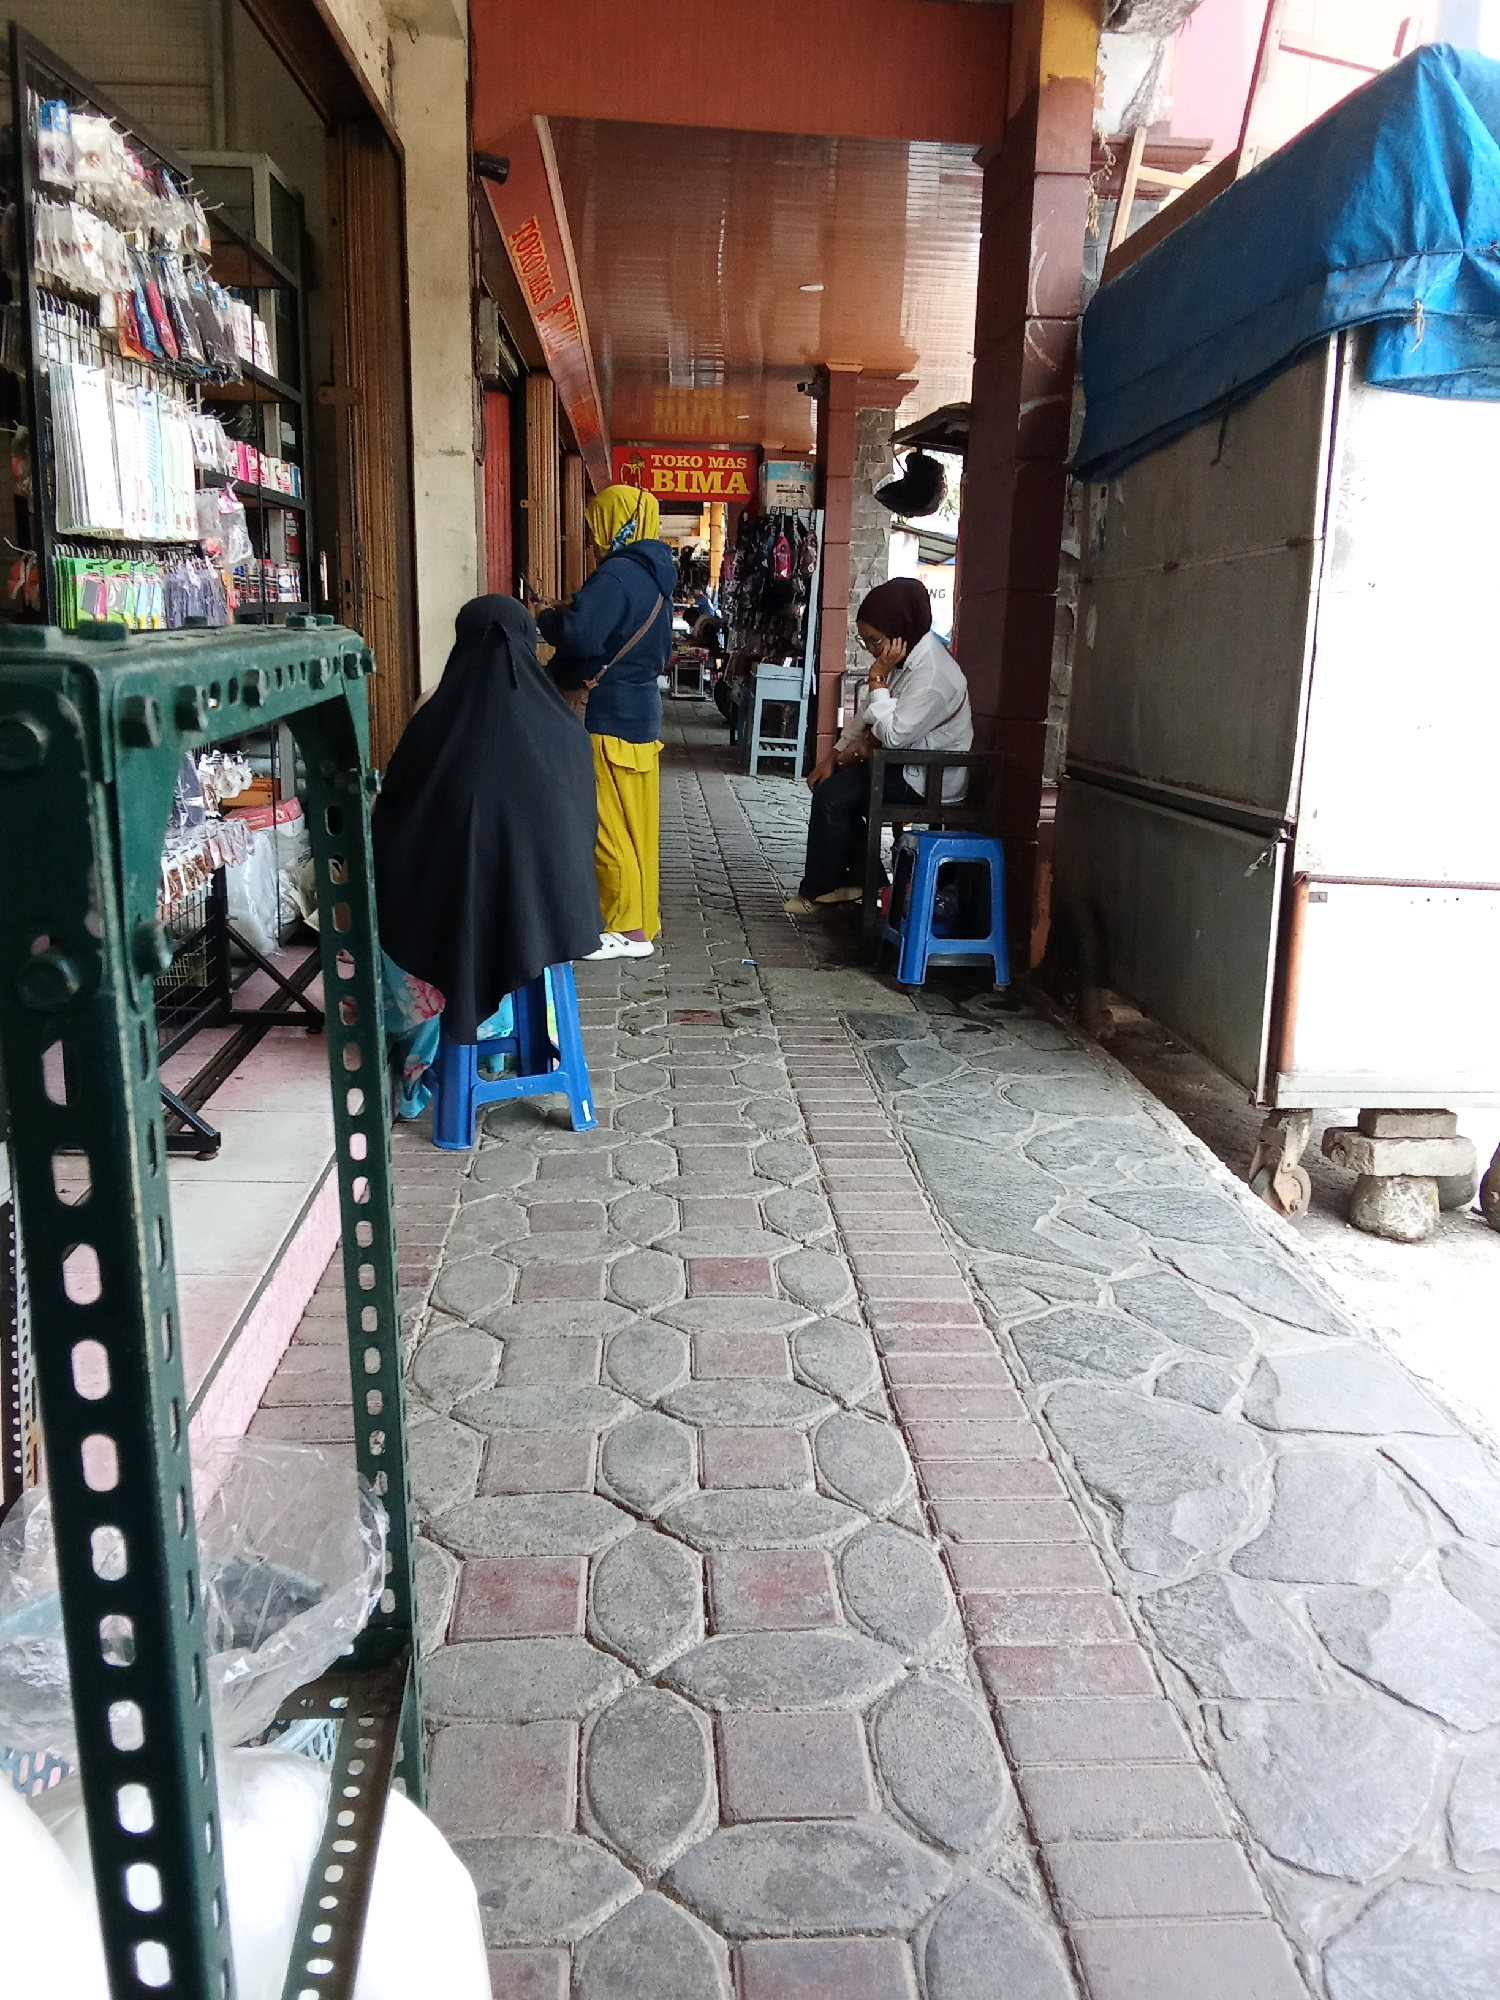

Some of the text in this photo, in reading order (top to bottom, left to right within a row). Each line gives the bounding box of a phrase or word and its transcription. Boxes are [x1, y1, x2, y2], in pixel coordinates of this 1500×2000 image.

[511, 217, 554, 305] TOKO MAS
[651, 455, 747, 469] TOKO MAS
[651, 469, 751, 494] BIMA
